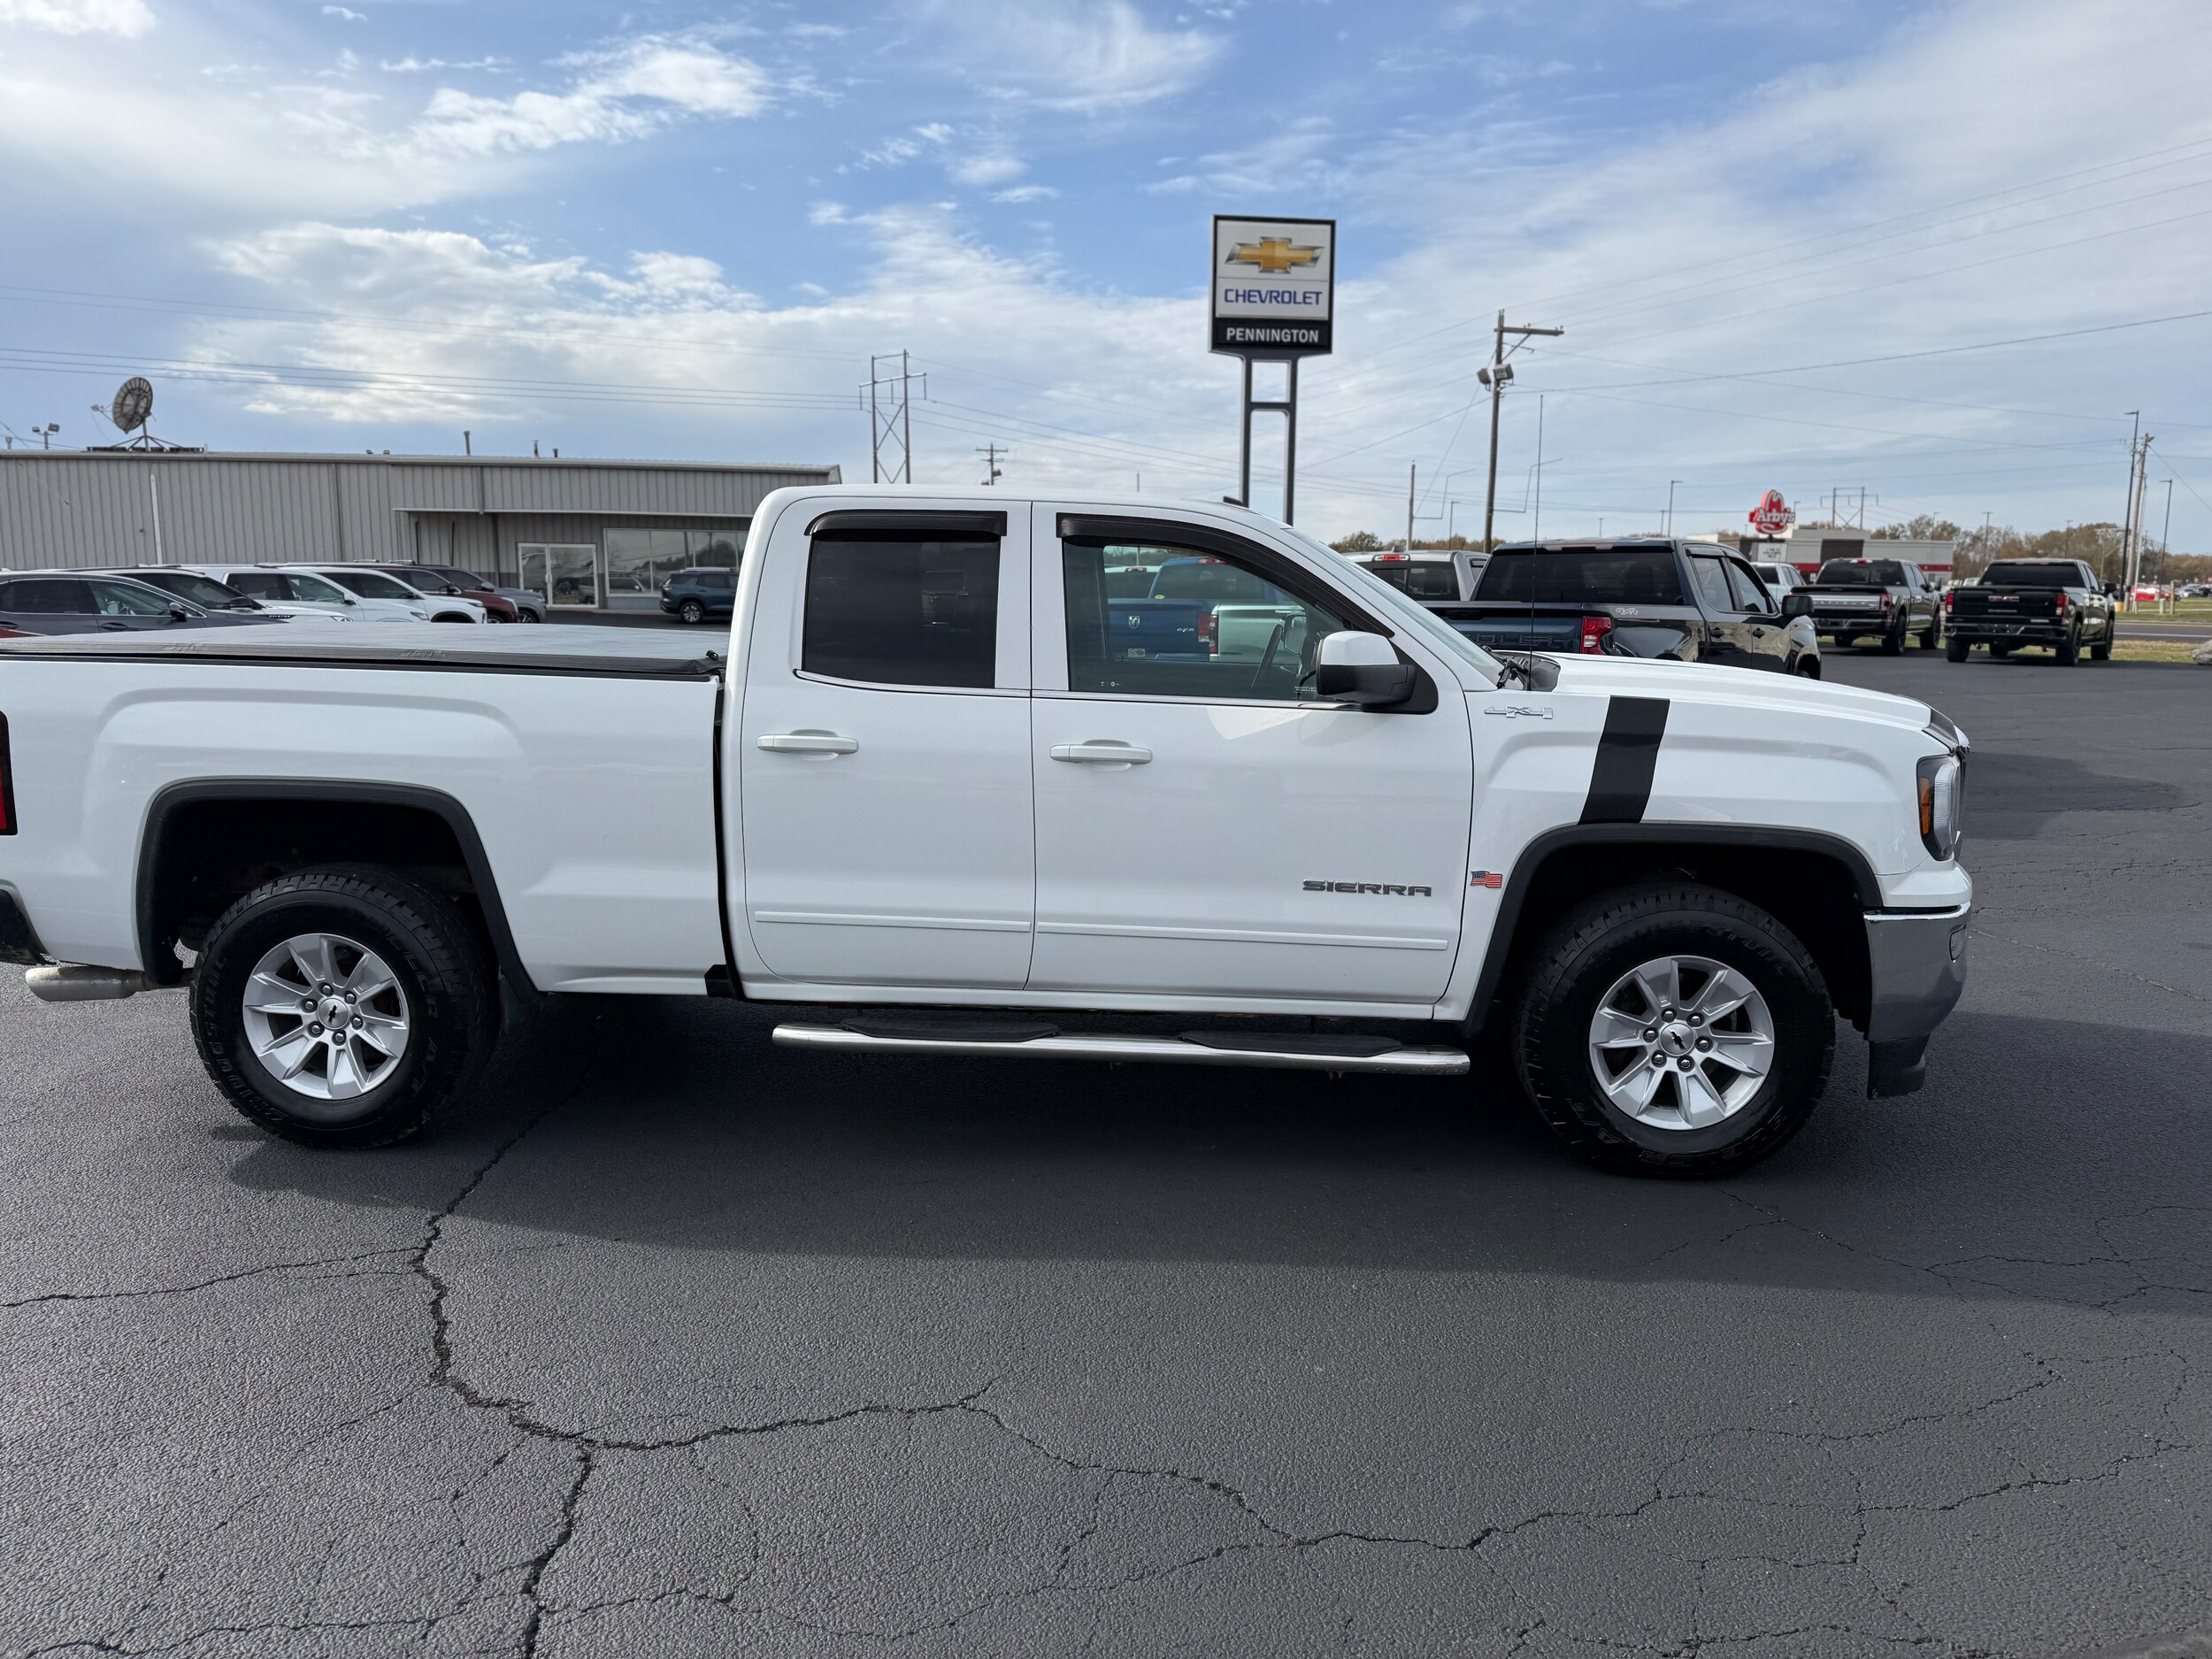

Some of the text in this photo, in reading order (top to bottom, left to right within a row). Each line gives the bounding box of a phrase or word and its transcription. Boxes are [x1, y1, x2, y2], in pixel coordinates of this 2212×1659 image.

[1225, 288, 1323, 305] CHEVROLET
[1226, 327, 1319, 342] PENNINGTON
[1756, 508, 1795, 526] Arby's
[1302, 879, 1432, 897] SIERRA
